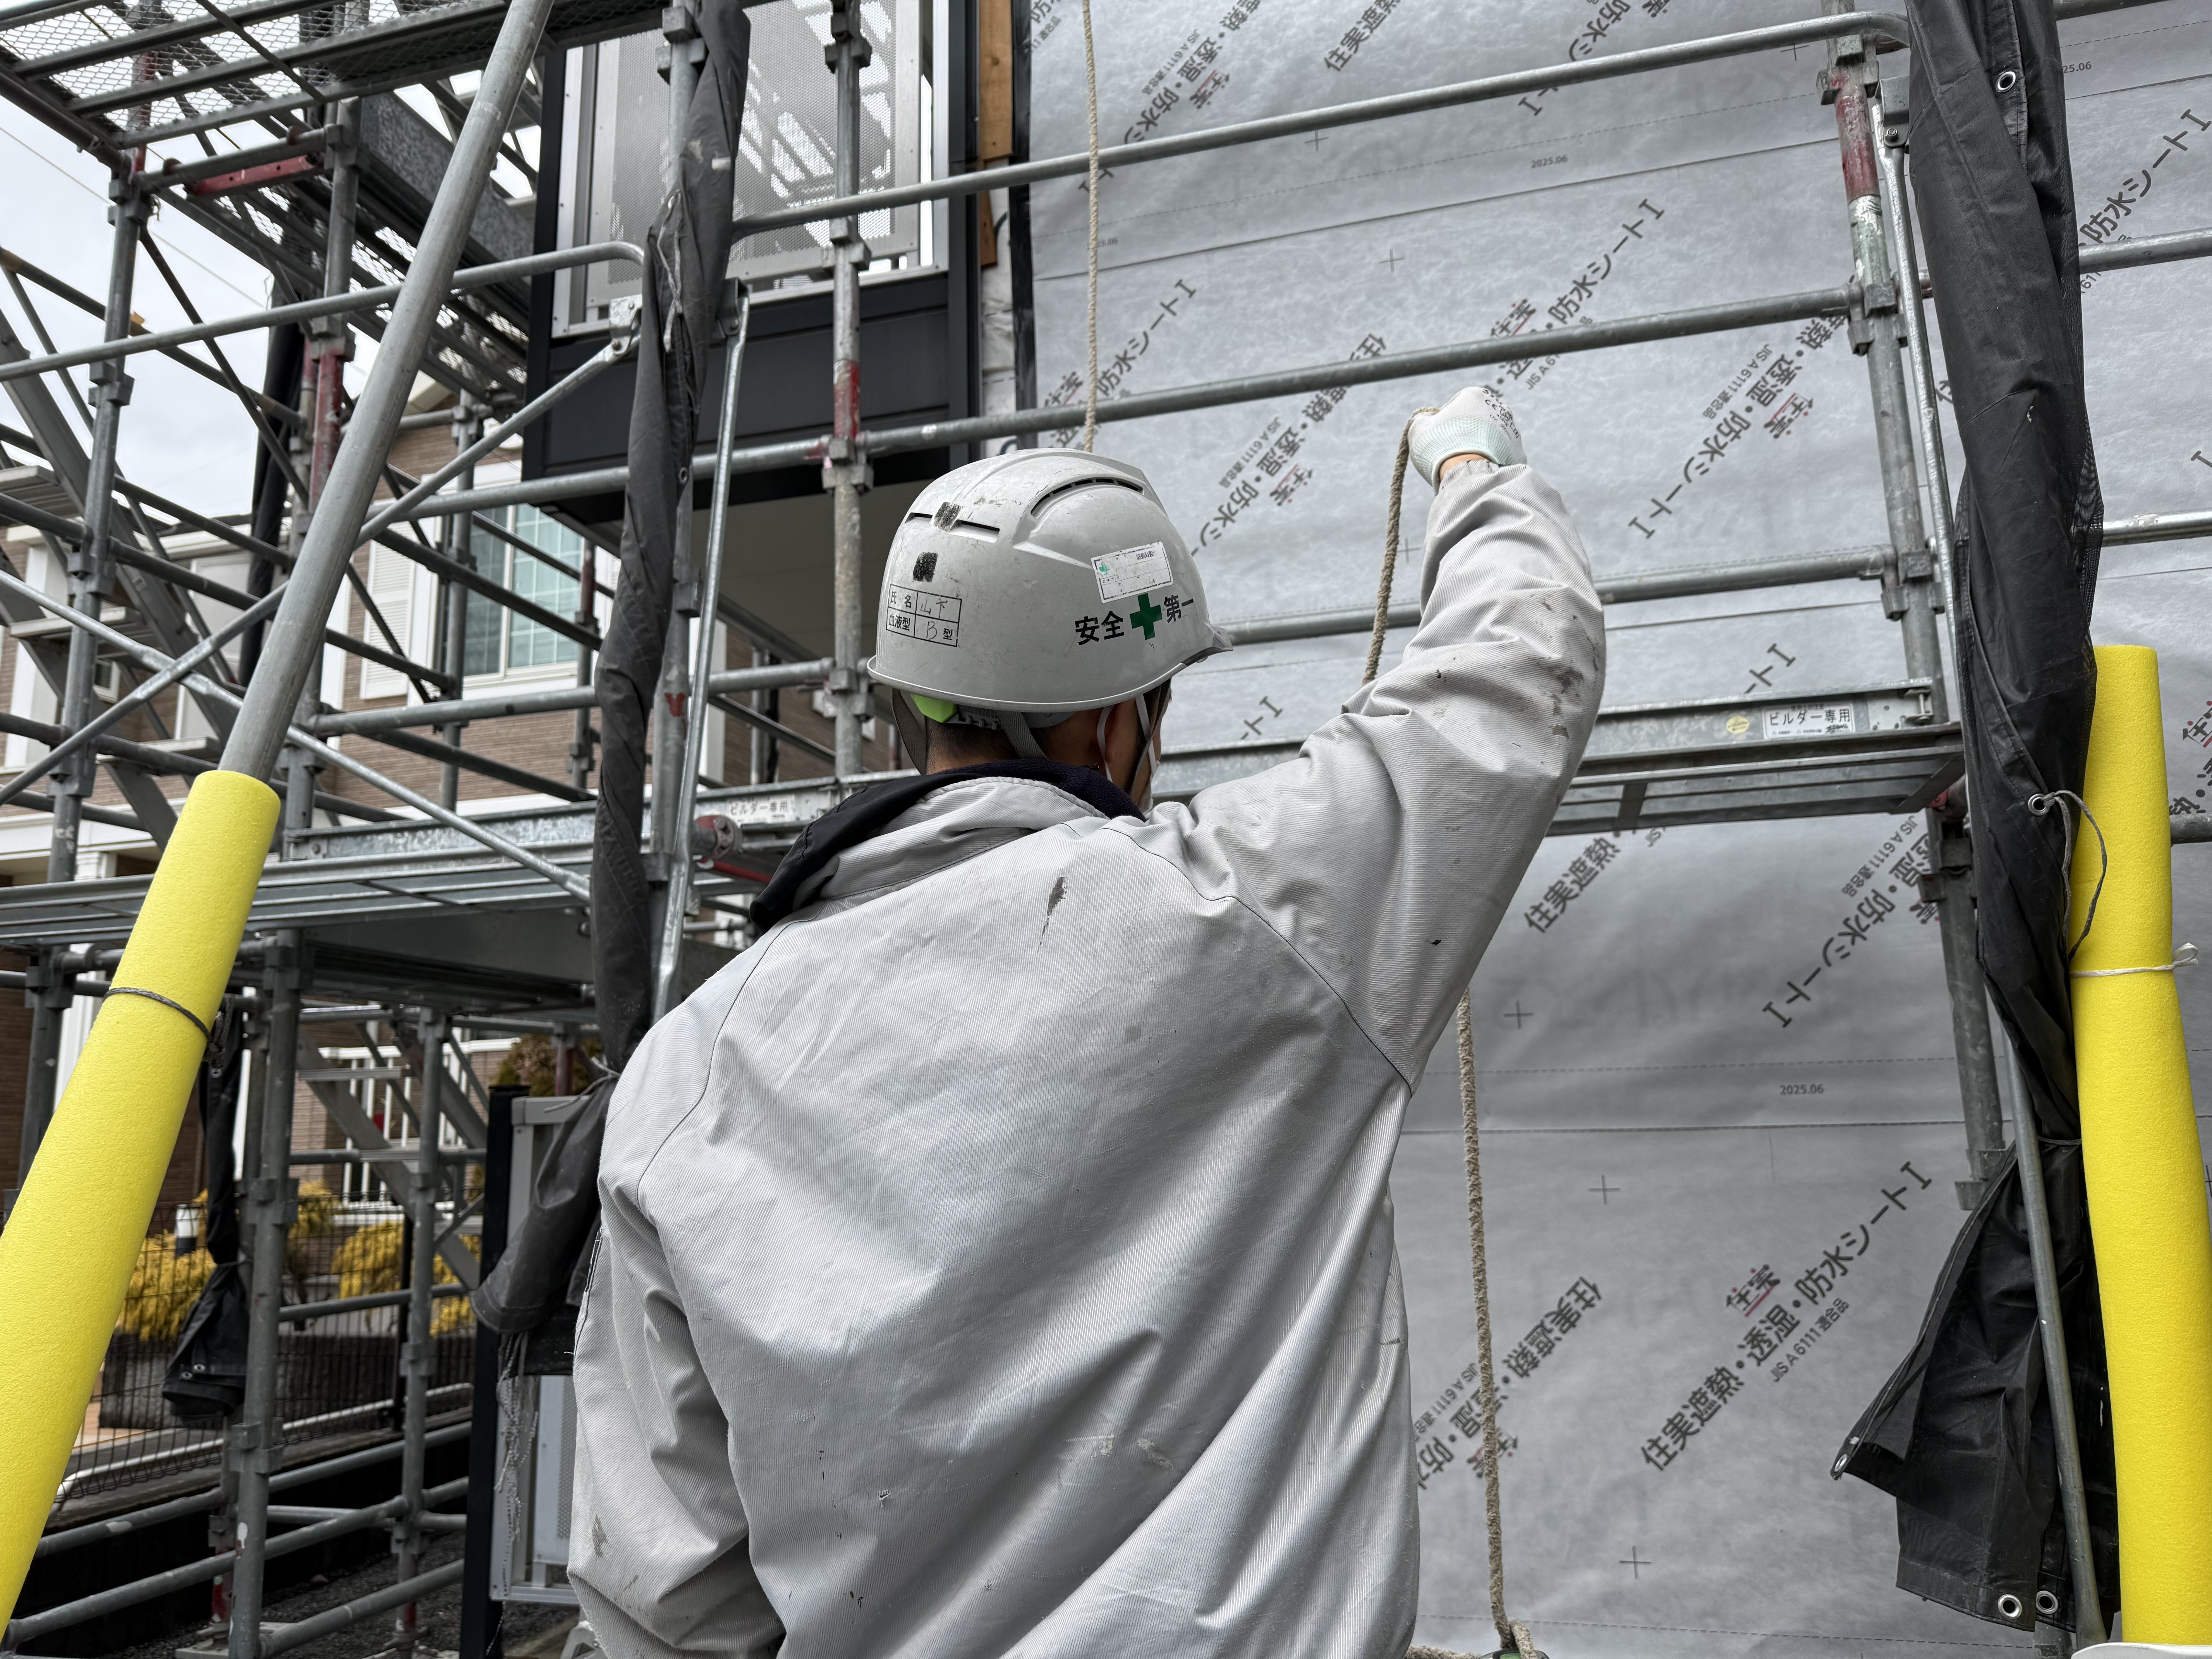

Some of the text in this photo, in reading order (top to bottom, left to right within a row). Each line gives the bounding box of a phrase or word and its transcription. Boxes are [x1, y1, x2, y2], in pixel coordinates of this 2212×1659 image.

[1531, 155, 1568, 168] 2025.06
[1756, 343, 1773, 361] JIS
[1747, 359, 1759, 369] A
[1526, 366, 1550, 390] JIS A
[1728, 369, 1752, 392] 6111
[891, 591, 911, 608] 氏名
[921, 598, 948, 619] 山下
[1074, 594, 1194, 646] 安全 第一
[1770, 708, 1850, 726] ビルダー専用
[1900, 815, 1917, 835] JIS
[1890, 831, 1903, 843] A
[1869, 842, 1895, 868] 6111
[1780, 1085, 1824, 1095] 2025.06
[1770, 1361, 1789, 1382] JIS
[1785, 1353, 1800, 1366] A
[1793, 1327, 1821, 1355] 6111
[1462, 1362, 1478, 1382] JIS
[1452, 1378, 1464, 1390] A
[1431, 1388, 1458, 1415] 6111
